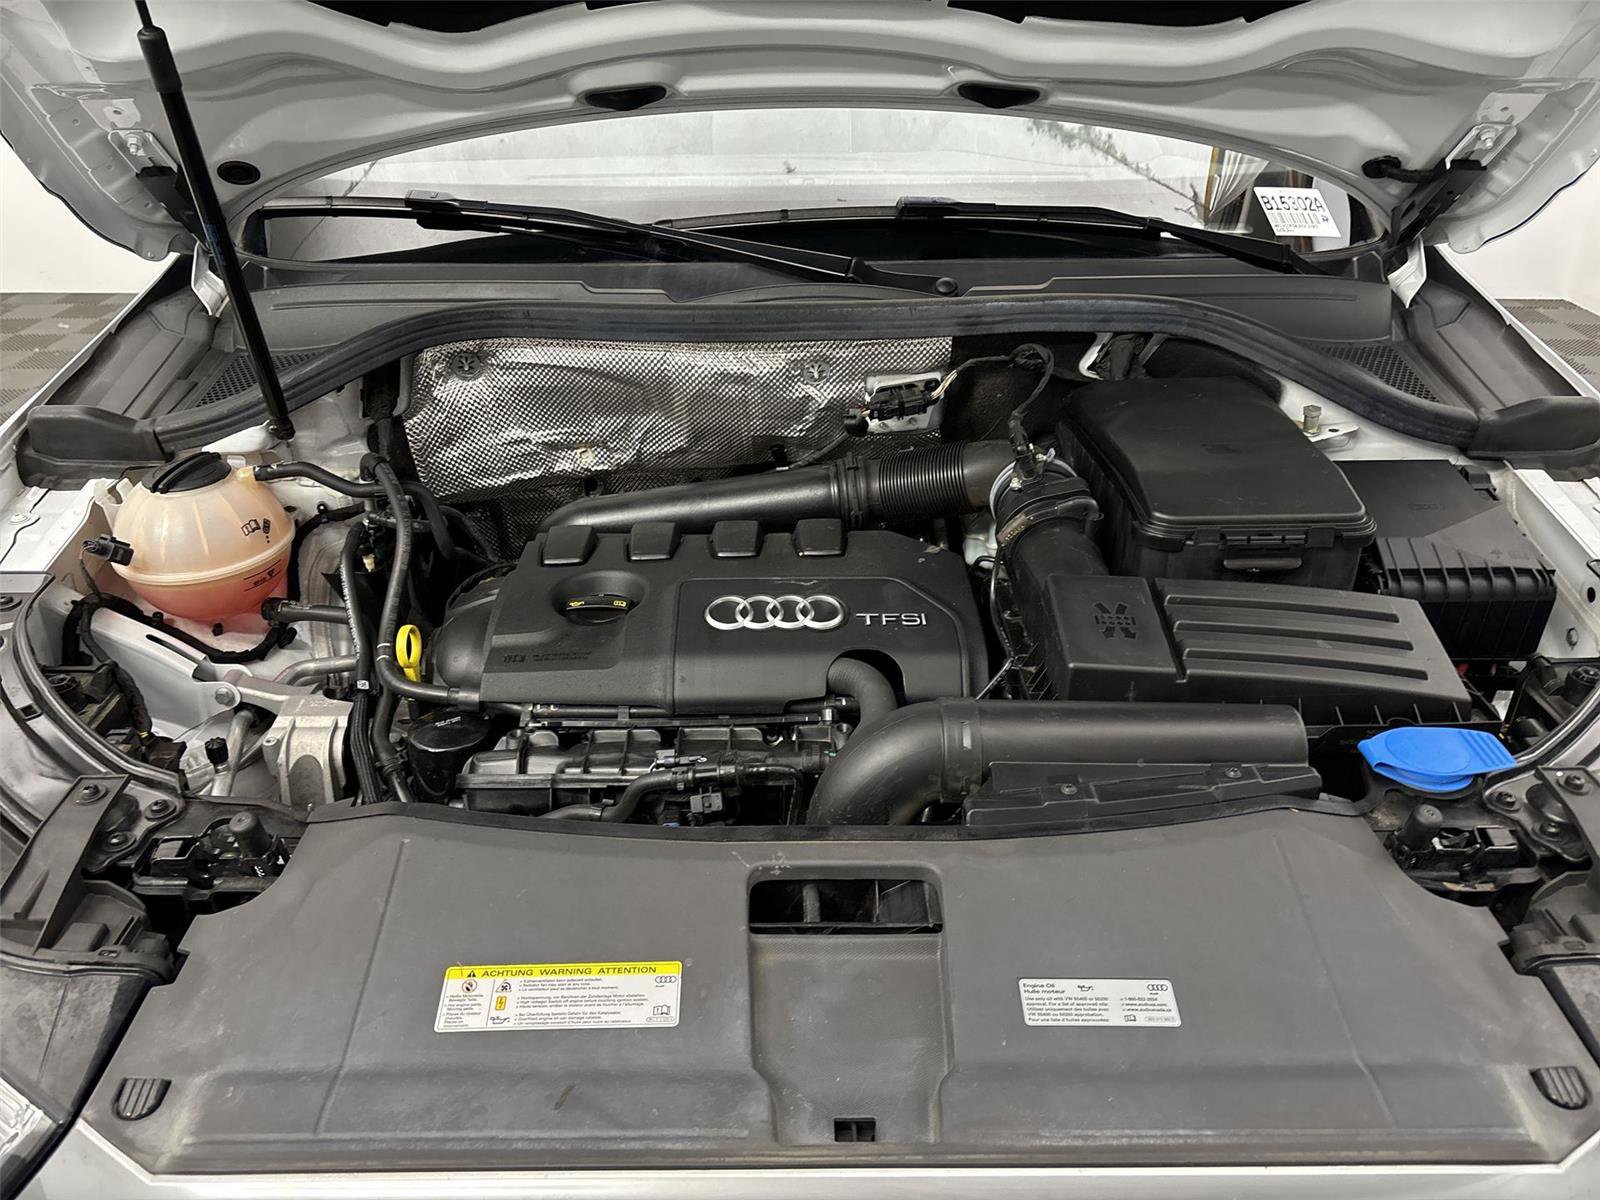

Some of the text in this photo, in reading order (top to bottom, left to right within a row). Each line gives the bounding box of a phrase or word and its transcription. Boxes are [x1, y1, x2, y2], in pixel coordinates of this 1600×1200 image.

[1261, 195, 1325, 212] B15302A
[856, 613, 926, 625] TFSI
[598, 967, 657, 975] ATTENTION
